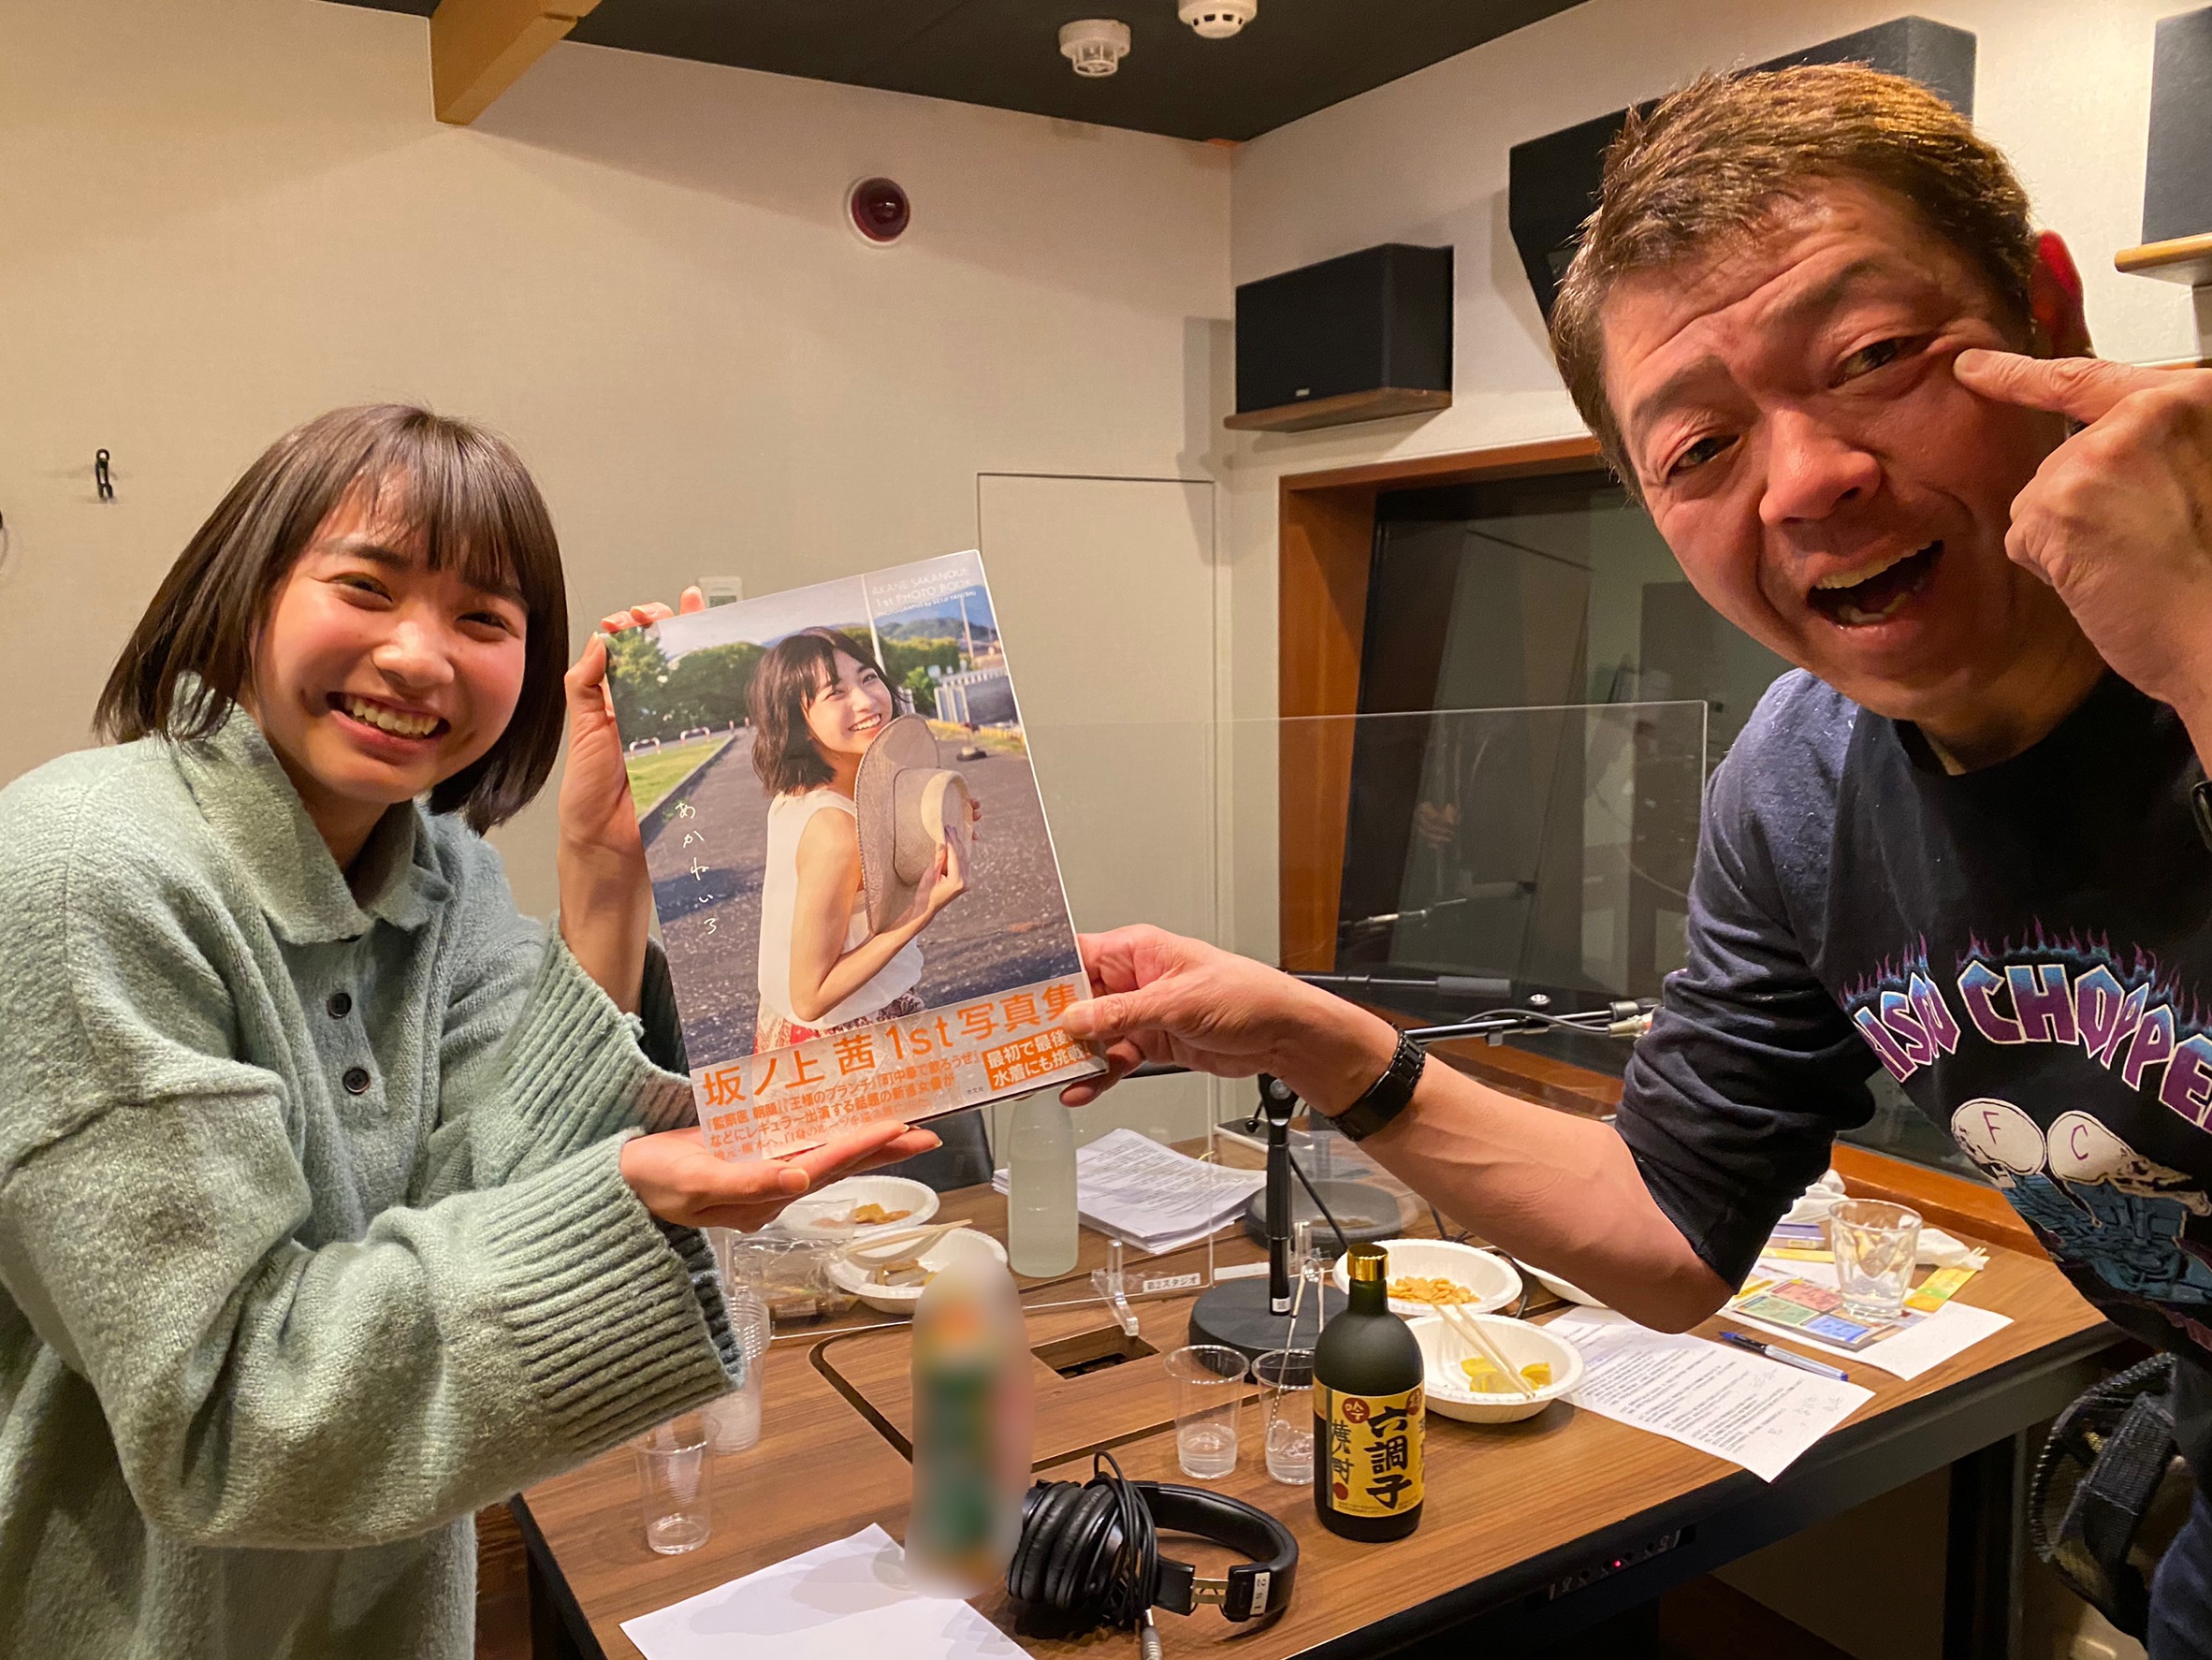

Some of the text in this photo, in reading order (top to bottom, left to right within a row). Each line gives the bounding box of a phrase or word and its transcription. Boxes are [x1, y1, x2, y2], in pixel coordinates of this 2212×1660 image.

[986, 1029, 1073, 1069] 最初で最後
[1957, 959, 2212, 1134] CHOPPE
[1364, 1405, 1412, 1509] 六調子
